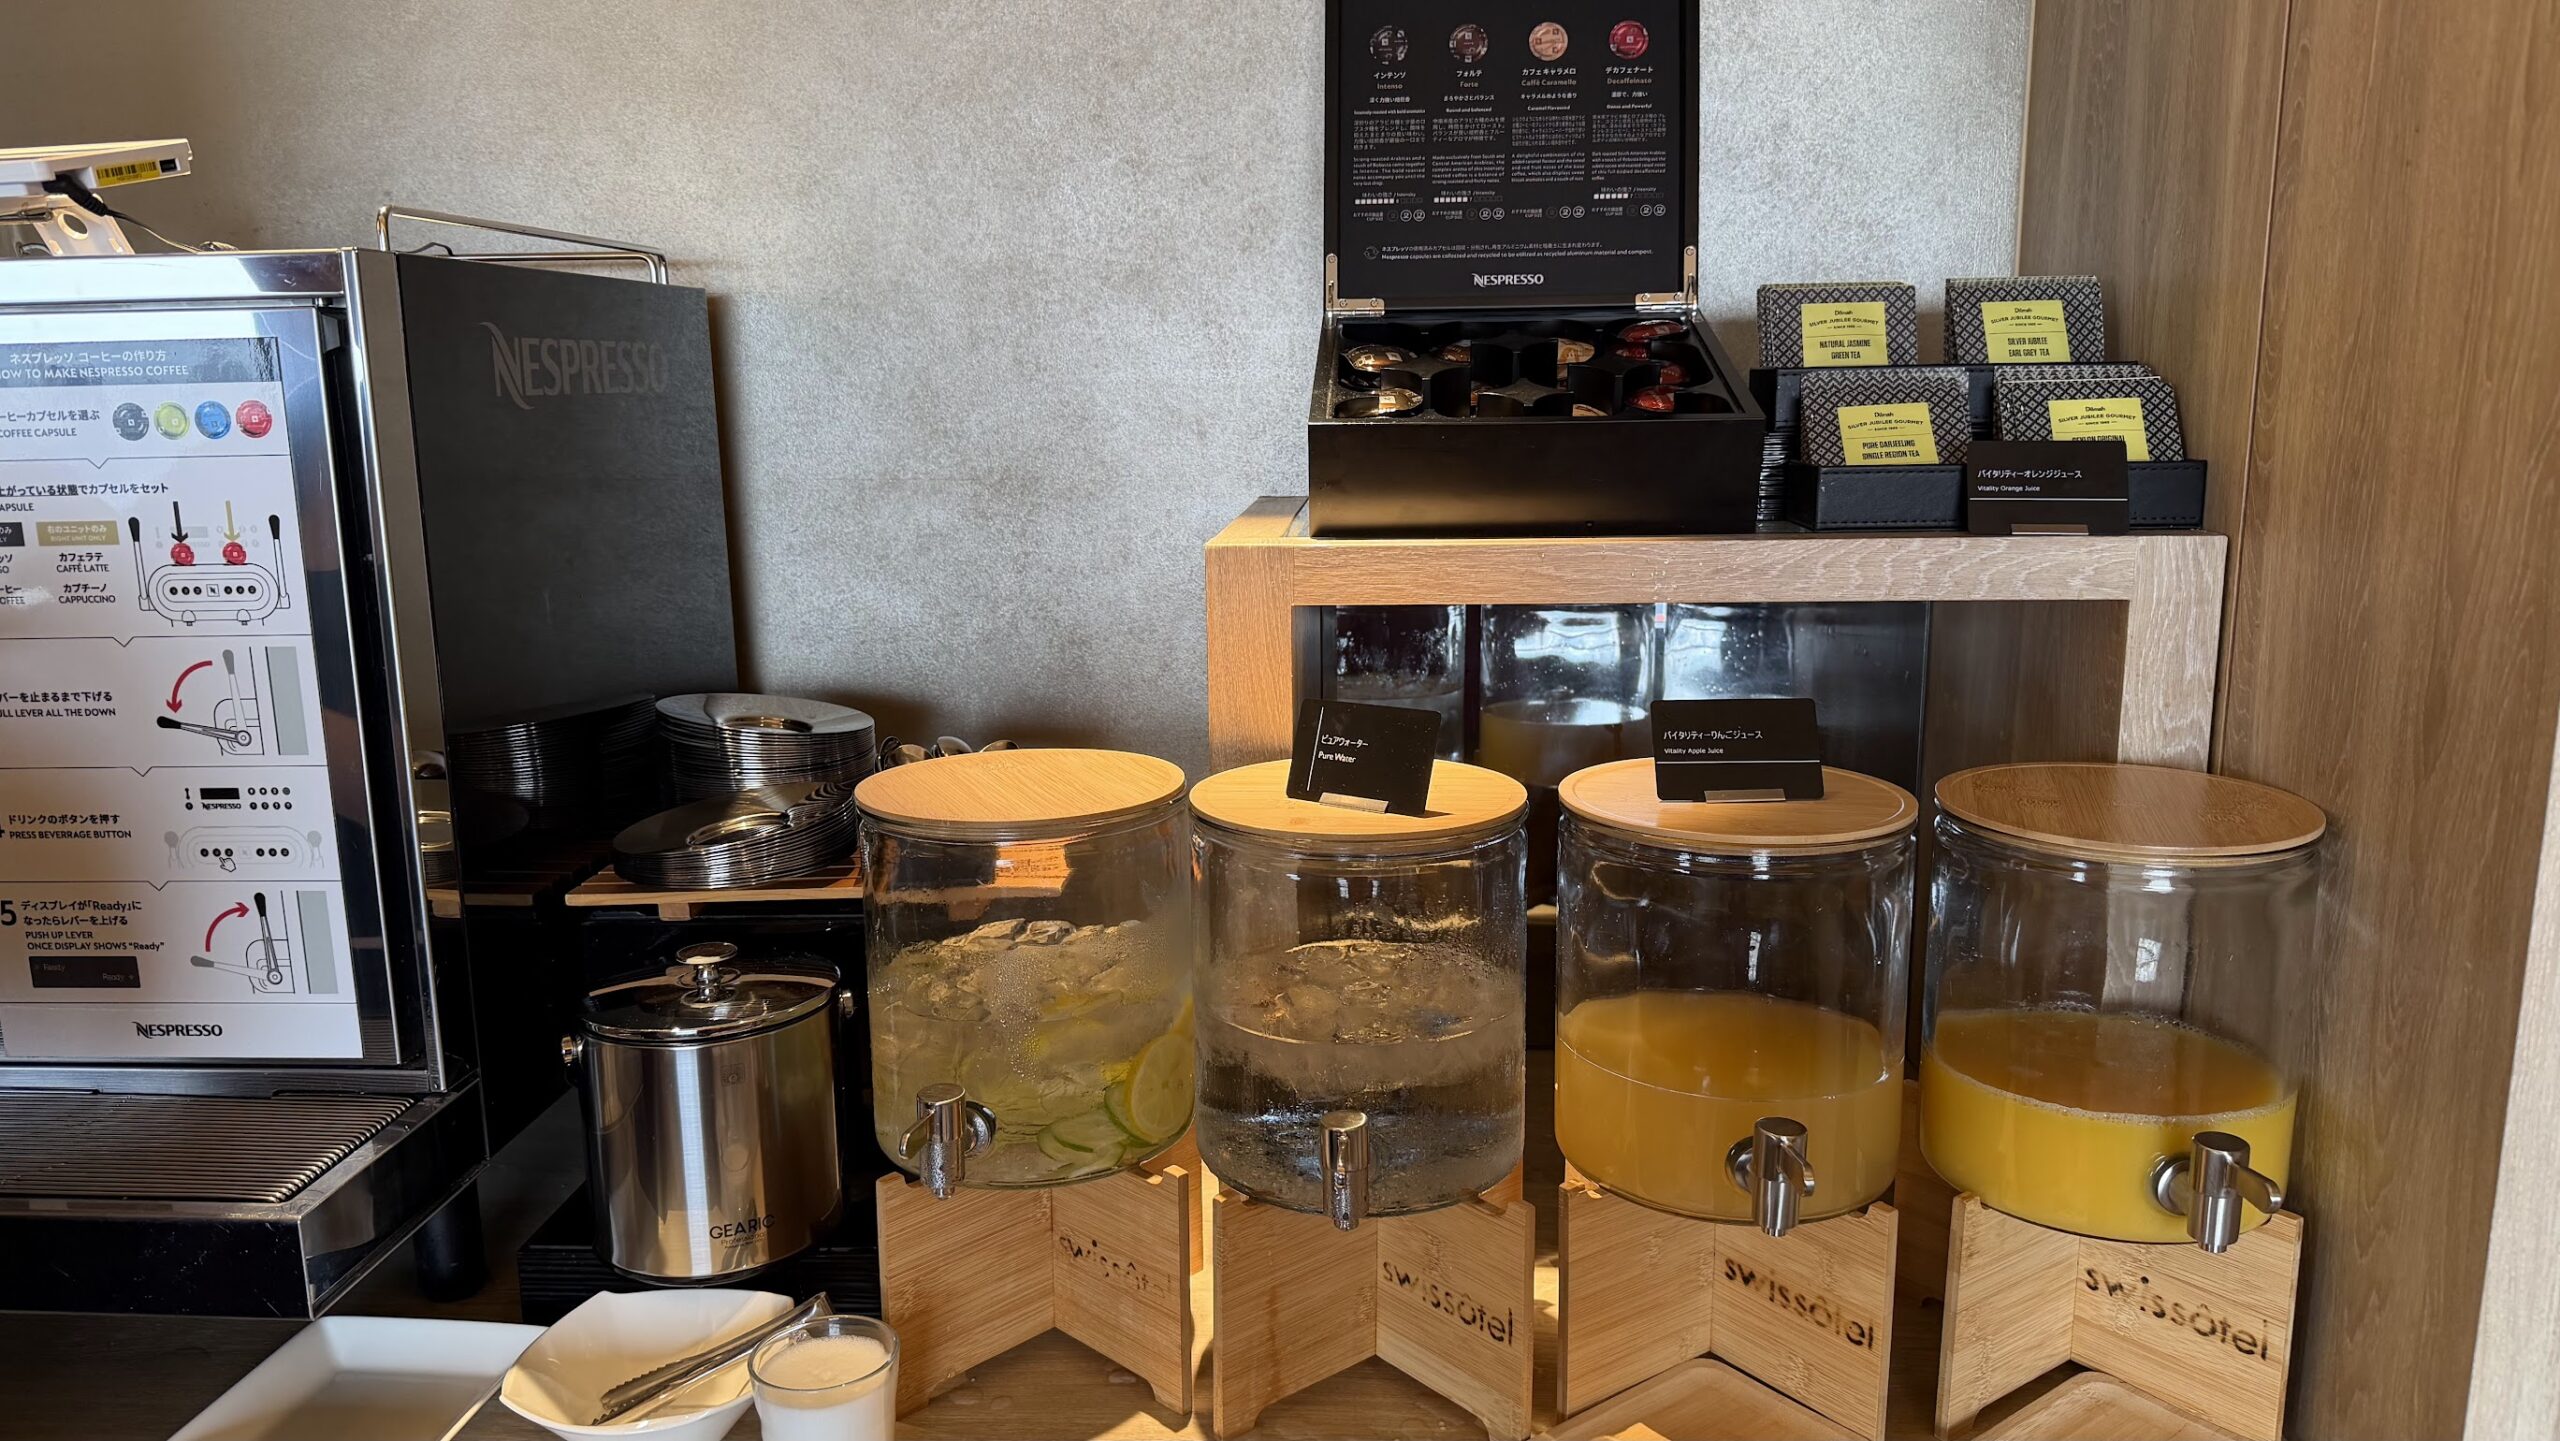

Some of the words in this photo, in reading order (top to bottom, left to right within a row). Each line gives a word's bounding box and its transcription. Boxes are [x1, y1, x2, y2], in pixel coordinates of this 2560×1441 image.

[1373, 71, 1406, 80] インテンソ
[1456, 69, 1483, 78] フォルテ
[1522, 68, 1542, 76] カフェ
[1543, 67, 1577, 75] キャラメロ
[1605, 66, 1654, 75] デカフェナート
[1541, 78, 1577, 86] Caramello
[1607, 77, 1653, 85] Decaffeinato
[1471, 272, 1545, 288] NESPRESSO
[1809, 319, 1828, 327] SILVER
[1852, 317, 1879, 326] GOURMET
[1990, 316, 2010, 325] SILVER
[2032, 315, 2060, 323] GOURMET
[1819, 339, 1847, 349] NATURAL
[1847, 338, 1872, 348] JASMINE
[2007, 337, 2027, 346] SILVER
[9, 350, 75, 365] ネスプレッソ
[79, 349, 167, 364] コーヒーの作り方
[1831, 351, 1850, 360] GREEN
[1850, 351, 1861, 360] TEA
[2008, 349, 2023, 358] EARL
[2022, 348, 2037, 357] GREY
[2038, 348, 2050, 357] TEA
[479, 321, 670, 410] NESPRESSO
[0, 368, 22, 380] OW
[25, 368, 41, 379] TO
[44, 368, 78, 379] MAKE
[79, 366, 143, 378] NESPRESSO
[145, 365, 190, 377] COFFEE
[1847, 421, 1868, 430] SILVER
[1893, 418, 1924, 426] GOURMET
[2057, 415, 2079, 424] SILVER
[2105, 413, 2137, 421] GOURMET
[34, 427, 78, 437] CAPSULE
[1862, 442, 1880, 450] PURE
[1879, 439, 1917, 449] DARJEELING
[1862, 451, 1884, 461] SINGLE
[1884, 450, 1908, 459] REGION
[1908, 449, 1921, 458] TEA
[1977, 468, 2083, 479] バイタリティーオレンジジュース
[1977, 485, 1999, 493] Vitality
[2000, 485, 2024, 493] Orange
[47, 524, 108, 535] 右のユニットのみ
[50, 535, 71, 543] RIGHT
[71, 535, 88, 543] UNIT
[88, 534, 107, 542] ONLY
[58, 552, 104, 563] カフェラテ
[83, 563, 110, 573] LATTE
[63, 583, 107, 594] カプチーノ
[58, 595, 116, 604] CAPPUCCINO
[0, 691, 113, 703] バーを止まるまで下げる
[15, 708, 44, 718] LEVER
[45, 708, 63, 717] ALL
[64, 707, 83, 717] THE
[84, 707, 117, 717] DOWN
[1663, 729, 1764, 741] バイタリティーりんごジュース
[1320, 733, 1370, 750] ピュアウォーター
[1663, 747, 1687, 755] Vitality
[1687, 747, 1707, 755] Apple
[1707, 747, 1725, 755] Juice
[1317, 750, 1335, 761] Pure
[1334, 752, 1357, 764] Water
[201, 802, 242, 811] NESPRESSO
[7, 813, 120, 825] ドリンクのボタンを押す
[8, 830, 38, 840] PRESS
[38, 830, 93, 839] BEVERRAGE
[93, 829, 132, 839] BUTTON
[20, 899, 143, 913] ディスプレイが「Ready」に
[0, 899, 18, 927] 5
[22, 914, 129, 927] なったらレバーを上げる
[25, 931, 50, 940] PUSH
[51, 930, 64, 940] UP
[65, 930, 94, 940] LEVER
[27, 942, 54, 951] ONCE
[54, 942, 91, 951] DISPLAY
[93, 941, 127, 951] SHOWS
[42, 962, 66, 974] Ready
[131, 1020, 223, 1039] NESPRESSO
[1382, 1258, 1515, 1346] swissôtel
[2084, 1263, 2270, 1362] swissôtel
